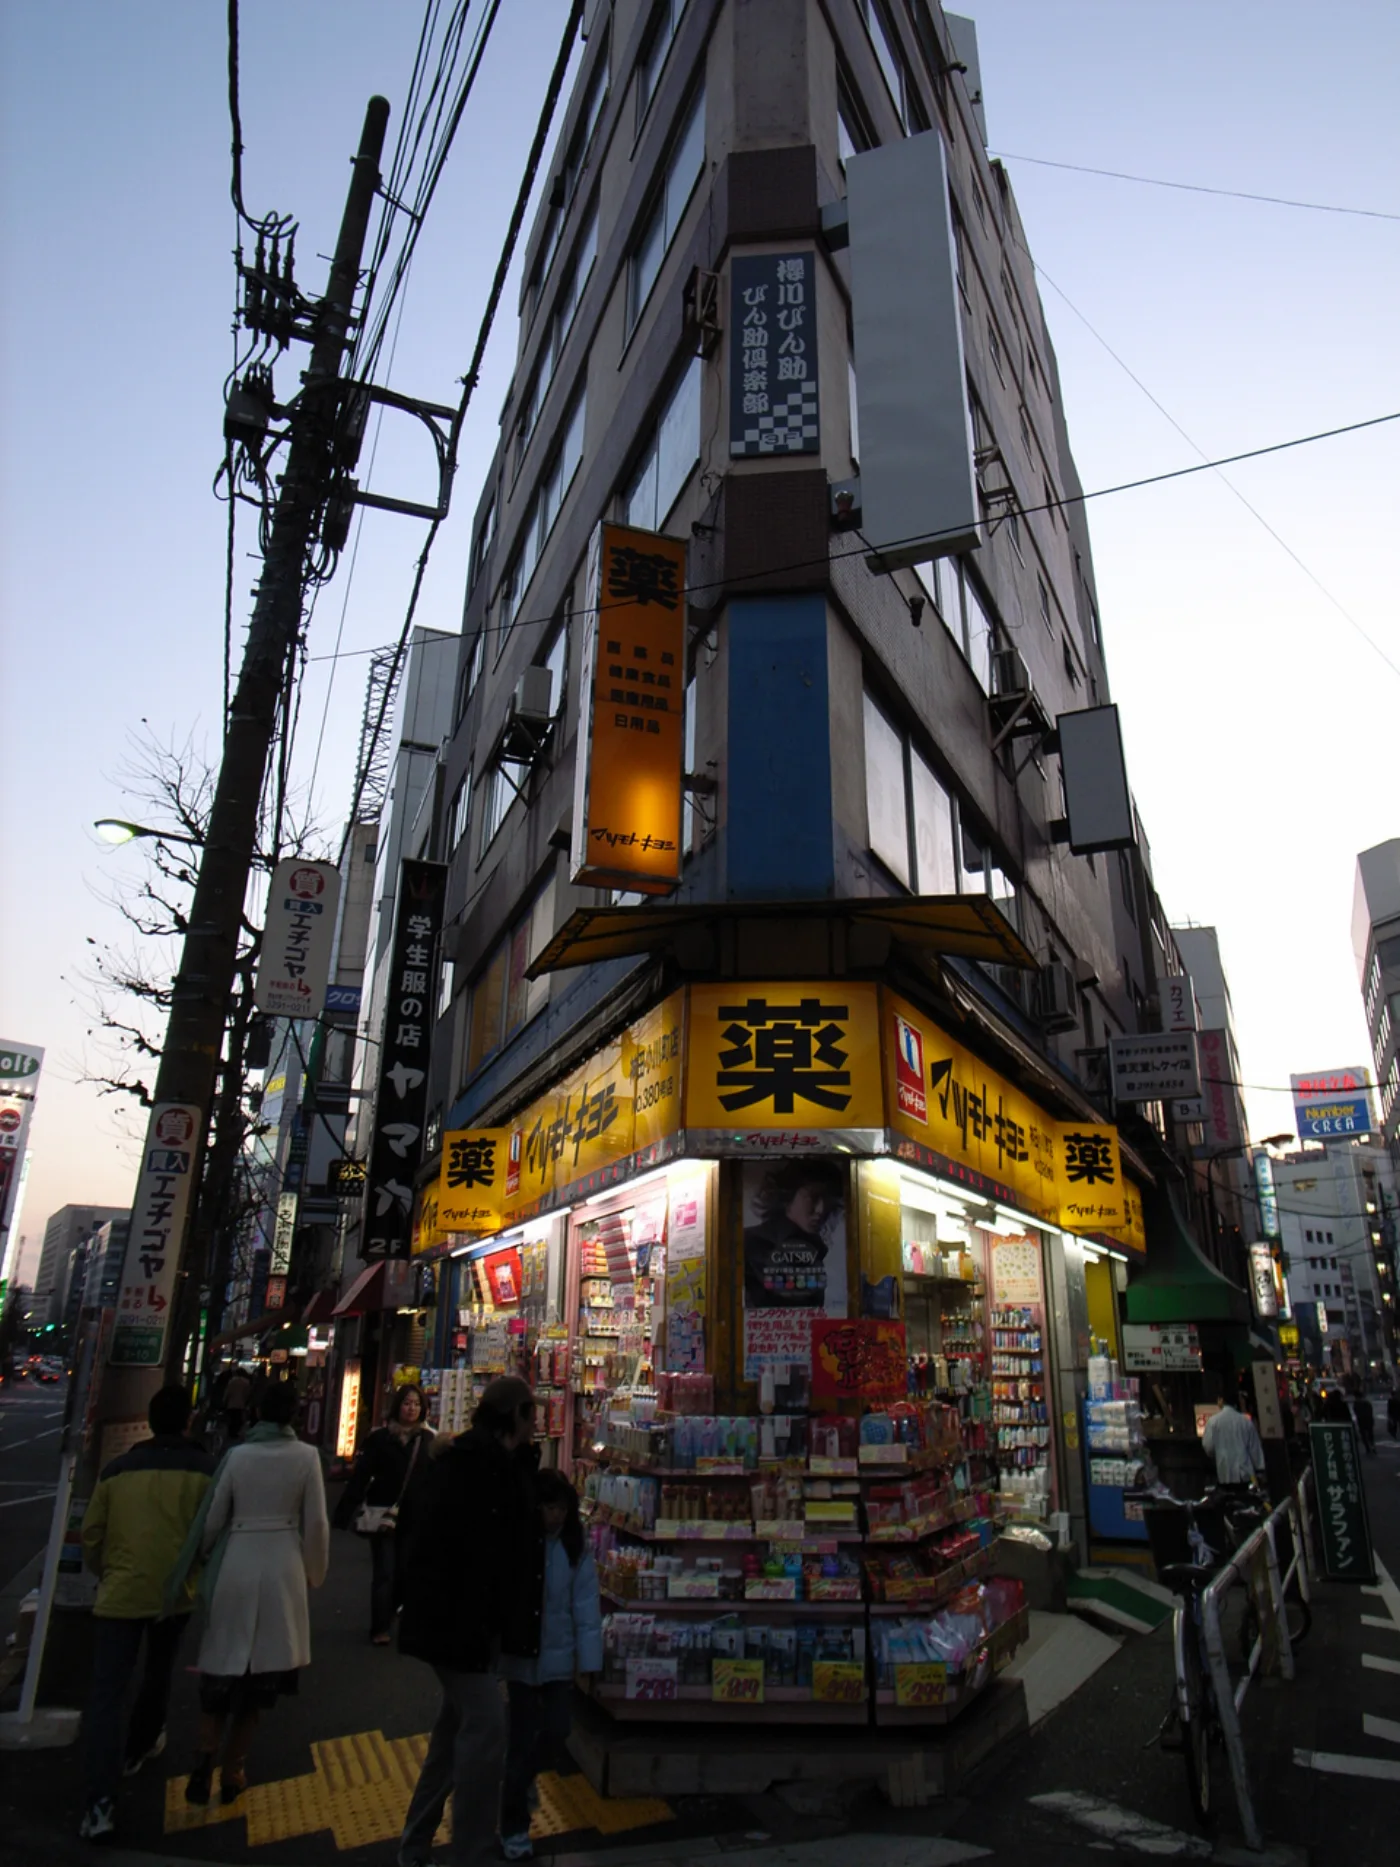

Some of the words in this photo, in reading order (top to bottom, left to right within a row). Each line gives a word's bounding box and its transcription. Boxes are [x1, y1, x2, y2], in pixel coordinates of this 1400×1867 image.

[608, 545, 679, 611] 薬
[590, 826, 676, 852] マツモトキヨシ
[283, 914, 312, 978] エチゴヤ
[395, 915, 432, 1049] 学生服の店
[716, 998, 853, 1114] 薬
[158, 1111, 191, 1142] 質
[526, 1081, 618, 1185] マツモトキヨシ
[930, 1058, 1029, 1170] マツモトキヨシ
[1305, 1104, 1355, 1121] Number
[1311, 1116, 1355, 1134] CREA
[447, 1137, 497, 1189] 薬
[746, 1133, 820, 1152] マツモトキヨシ
[1063, 1132, 1115, 1185] 薬
[139, 1176, 176, 1279] エチゴヤ
[368, 1238, 402, 1255] 2F
[770, 1249, 819, 1265] GATSBY
